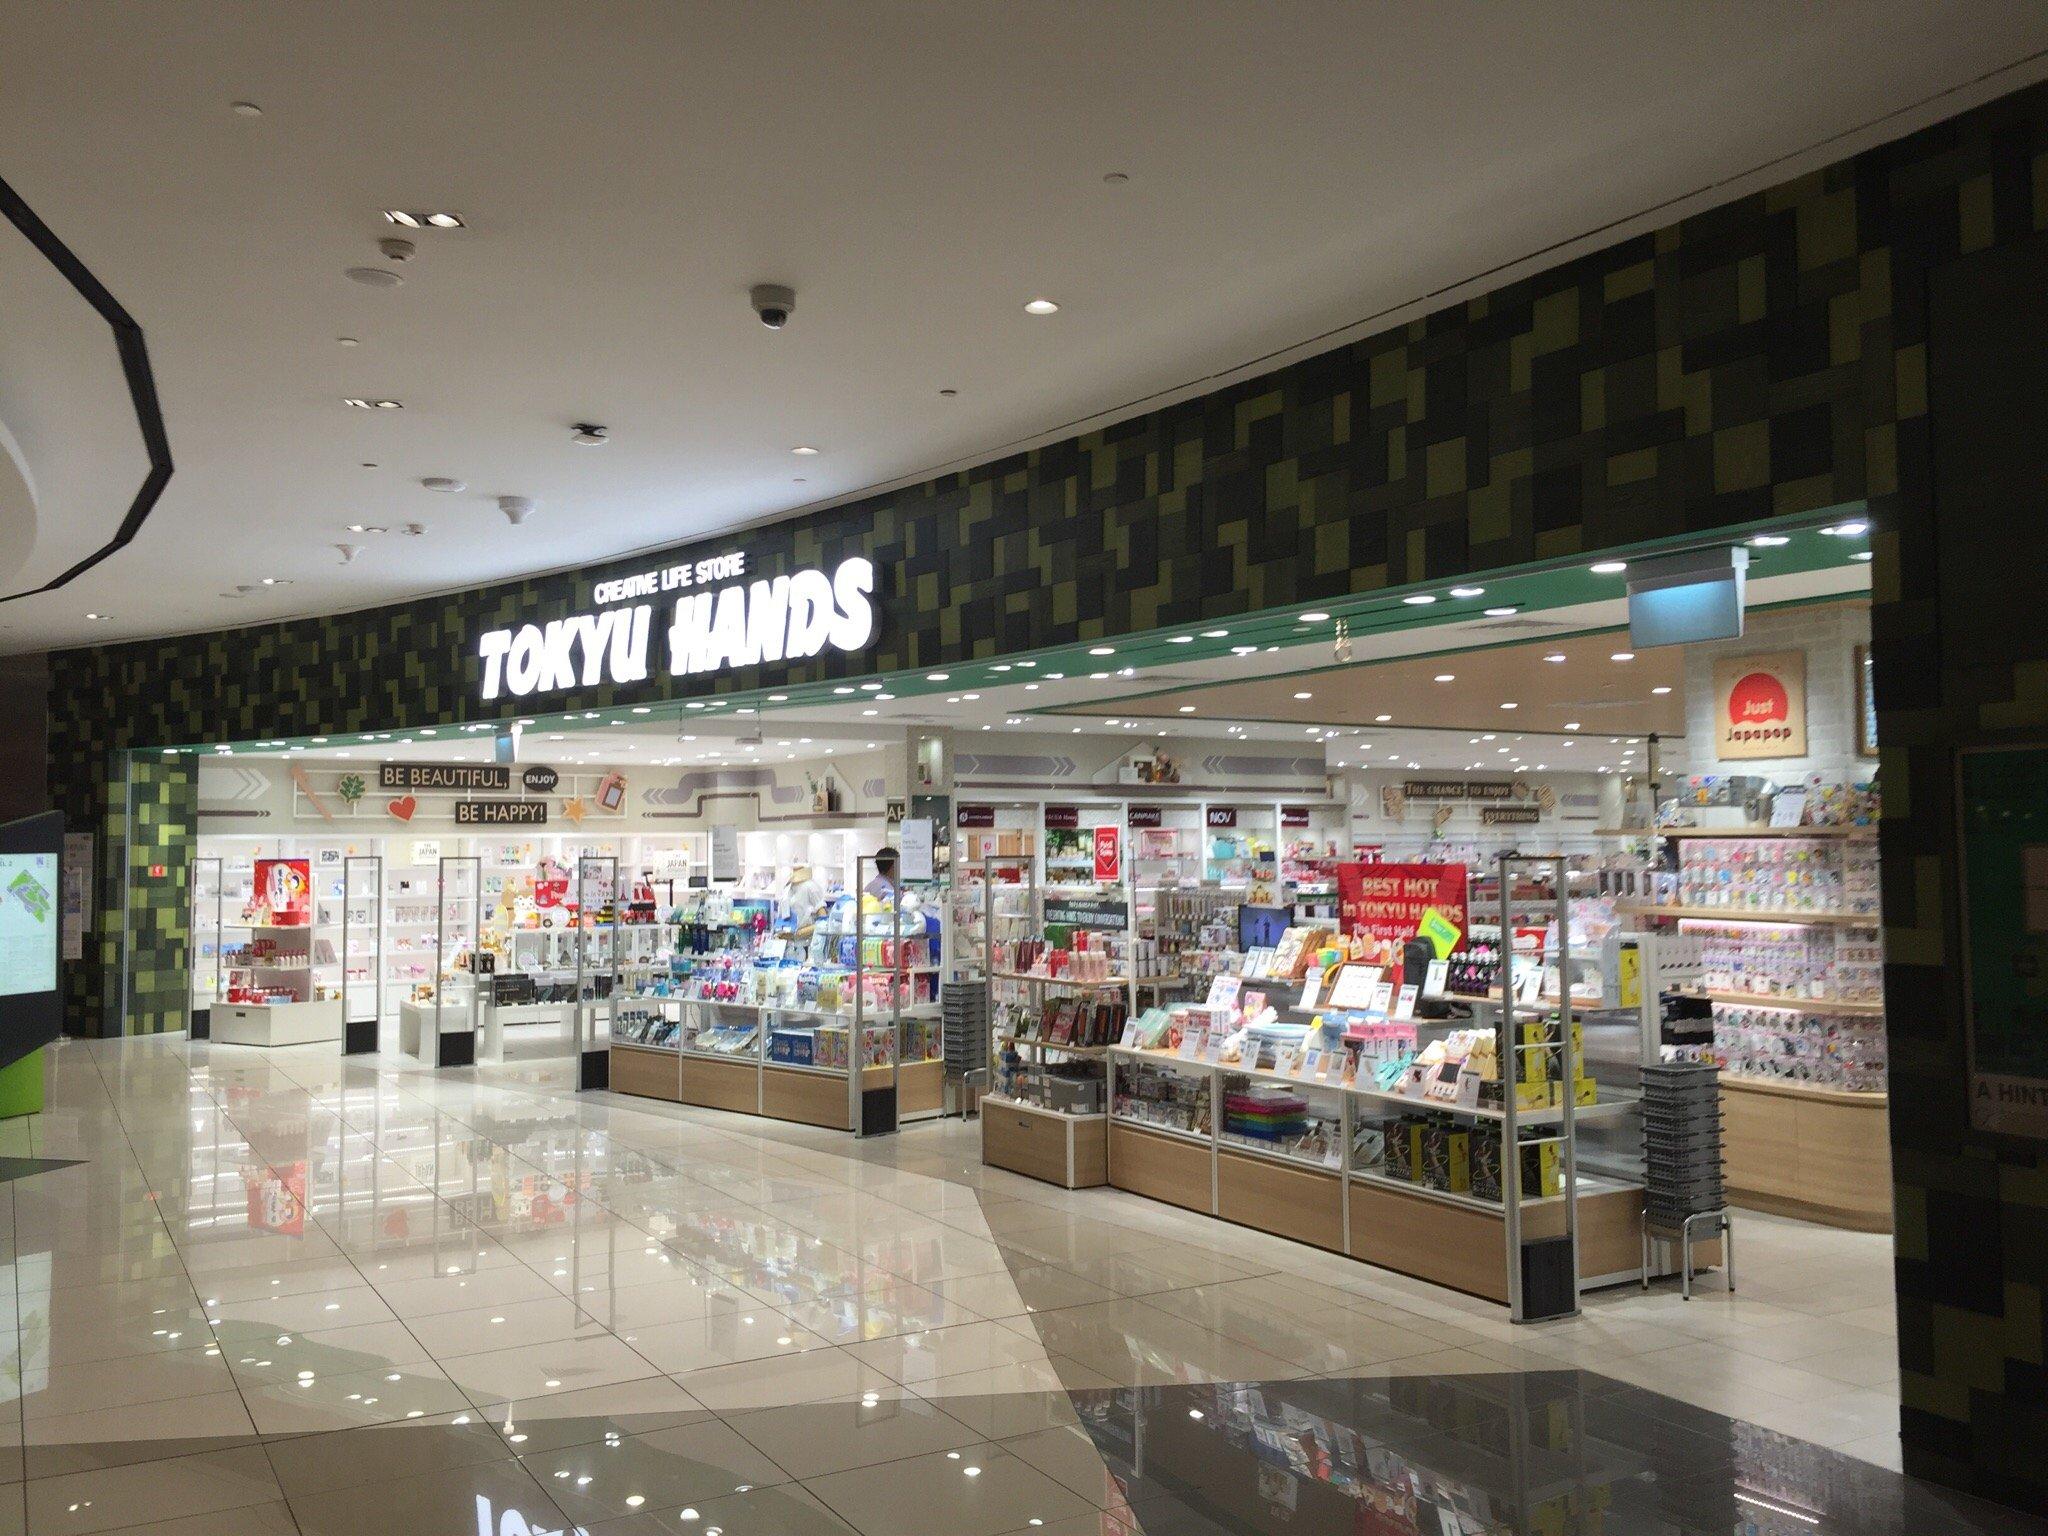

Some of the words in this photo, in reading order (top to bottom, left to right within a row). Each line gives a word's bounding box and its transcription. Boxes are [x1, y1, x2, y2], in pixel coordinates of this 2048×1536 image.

[594, 571, 658, 605] CREATIVE
[661, 564, 693, 591] LIFE
[695, 551, 745, 585] STORE
[479, 605, 651, 700] TOKYU
[669, 557, 874, 676] HANDS
[1743, 699, 1774, 716] Just
[384, 767, 405, 785] BE
[410, 769, 508, 789] BEAUTIFUL,
[525, 774, 556, 785] ENJOY
[459, 804, 479, 821] BE
[484, 805, 544, 821] HAPPY!
[1209, 811, 1232, 824] NOV
[419, 848, 437, 856] JAPAN
[1362, 877, 1401, 897] BEST
[1403, 877, 1440, 899] HOT
[1342, 900, 1357, 918] in
[1357, 901, 1407, 920] TOKYU
[1371, 924, 1394, 937] First
